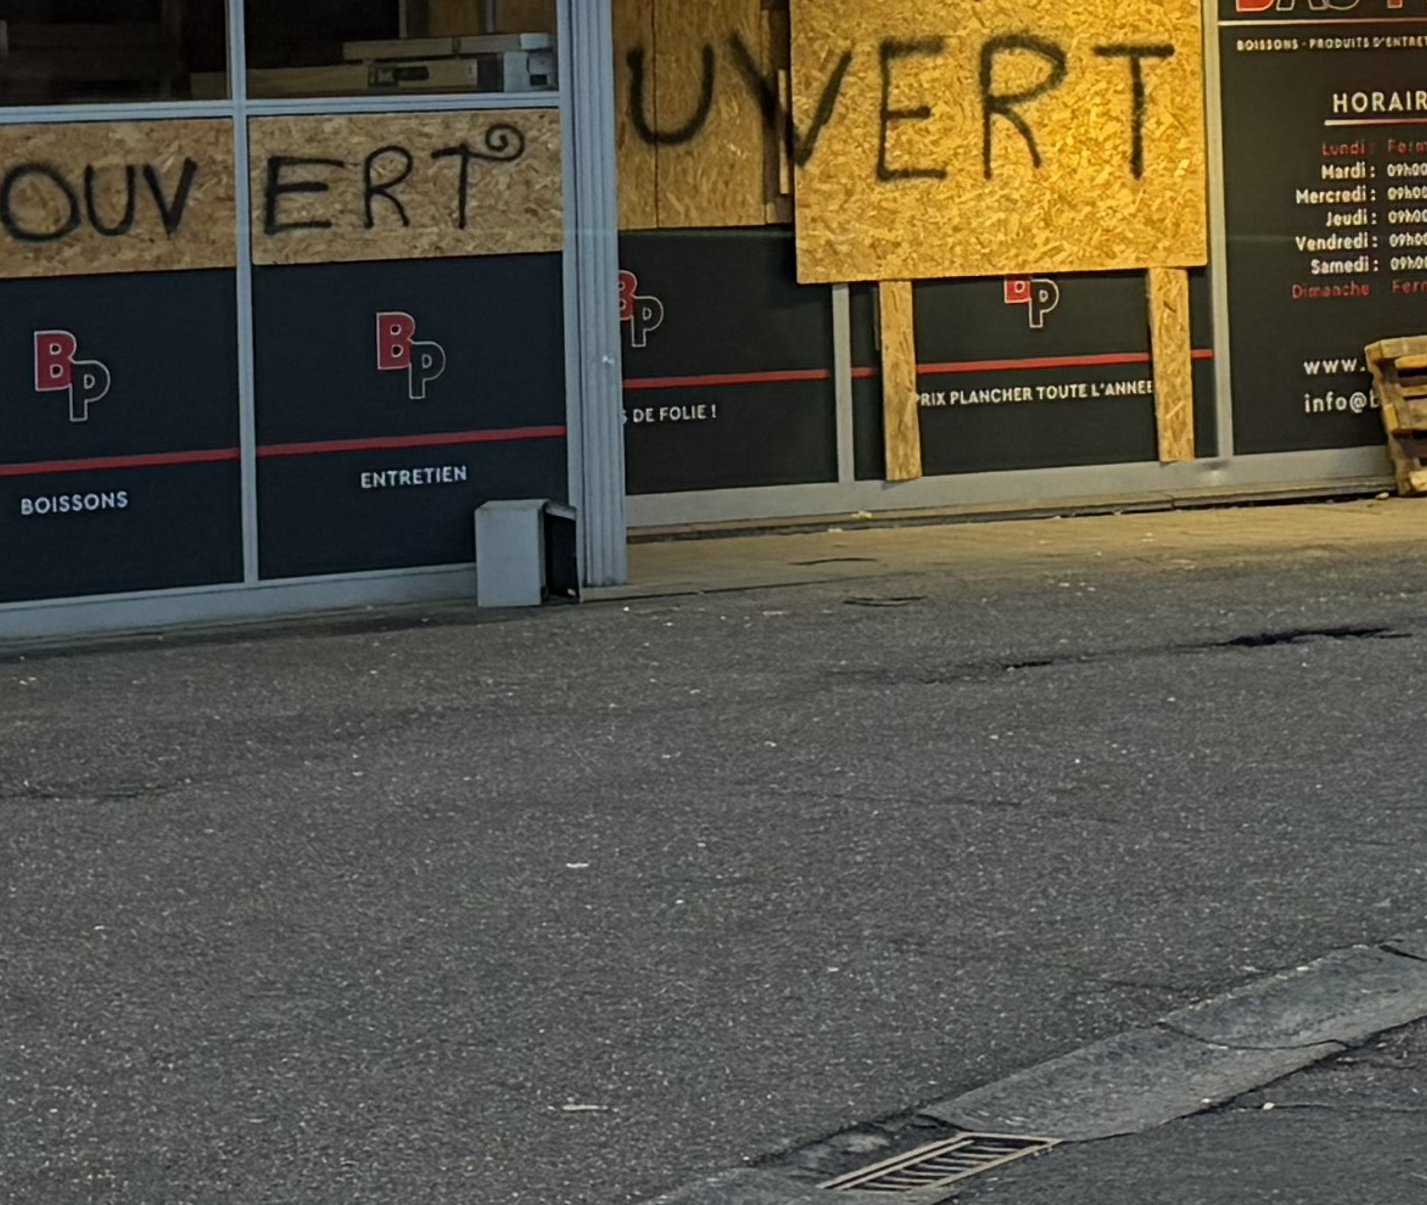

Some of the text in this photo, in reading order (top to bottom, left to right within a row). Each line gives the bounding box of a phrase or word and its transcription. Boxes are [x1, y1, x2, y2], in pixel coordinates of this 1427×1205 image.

[1236, 39, 1299, 51] BOISSONS
[1309, 36, 1370, 48] PRODUITS
[1292, 281, 1370, 299] Dimanche
[377, 311, 446, 399] BP
[34, 330, 111, 421] BP
[950, 386, 1033, 405] PLANCHER
[1035, 383, 1088, 400] TOUTE
[633, 407, 655, 423] DE
[659, 404, 706, 421] FOLIE
[360, 465, 468, 489] ENTRETIEN
[20, 491, 128, 516] BOISSONS
